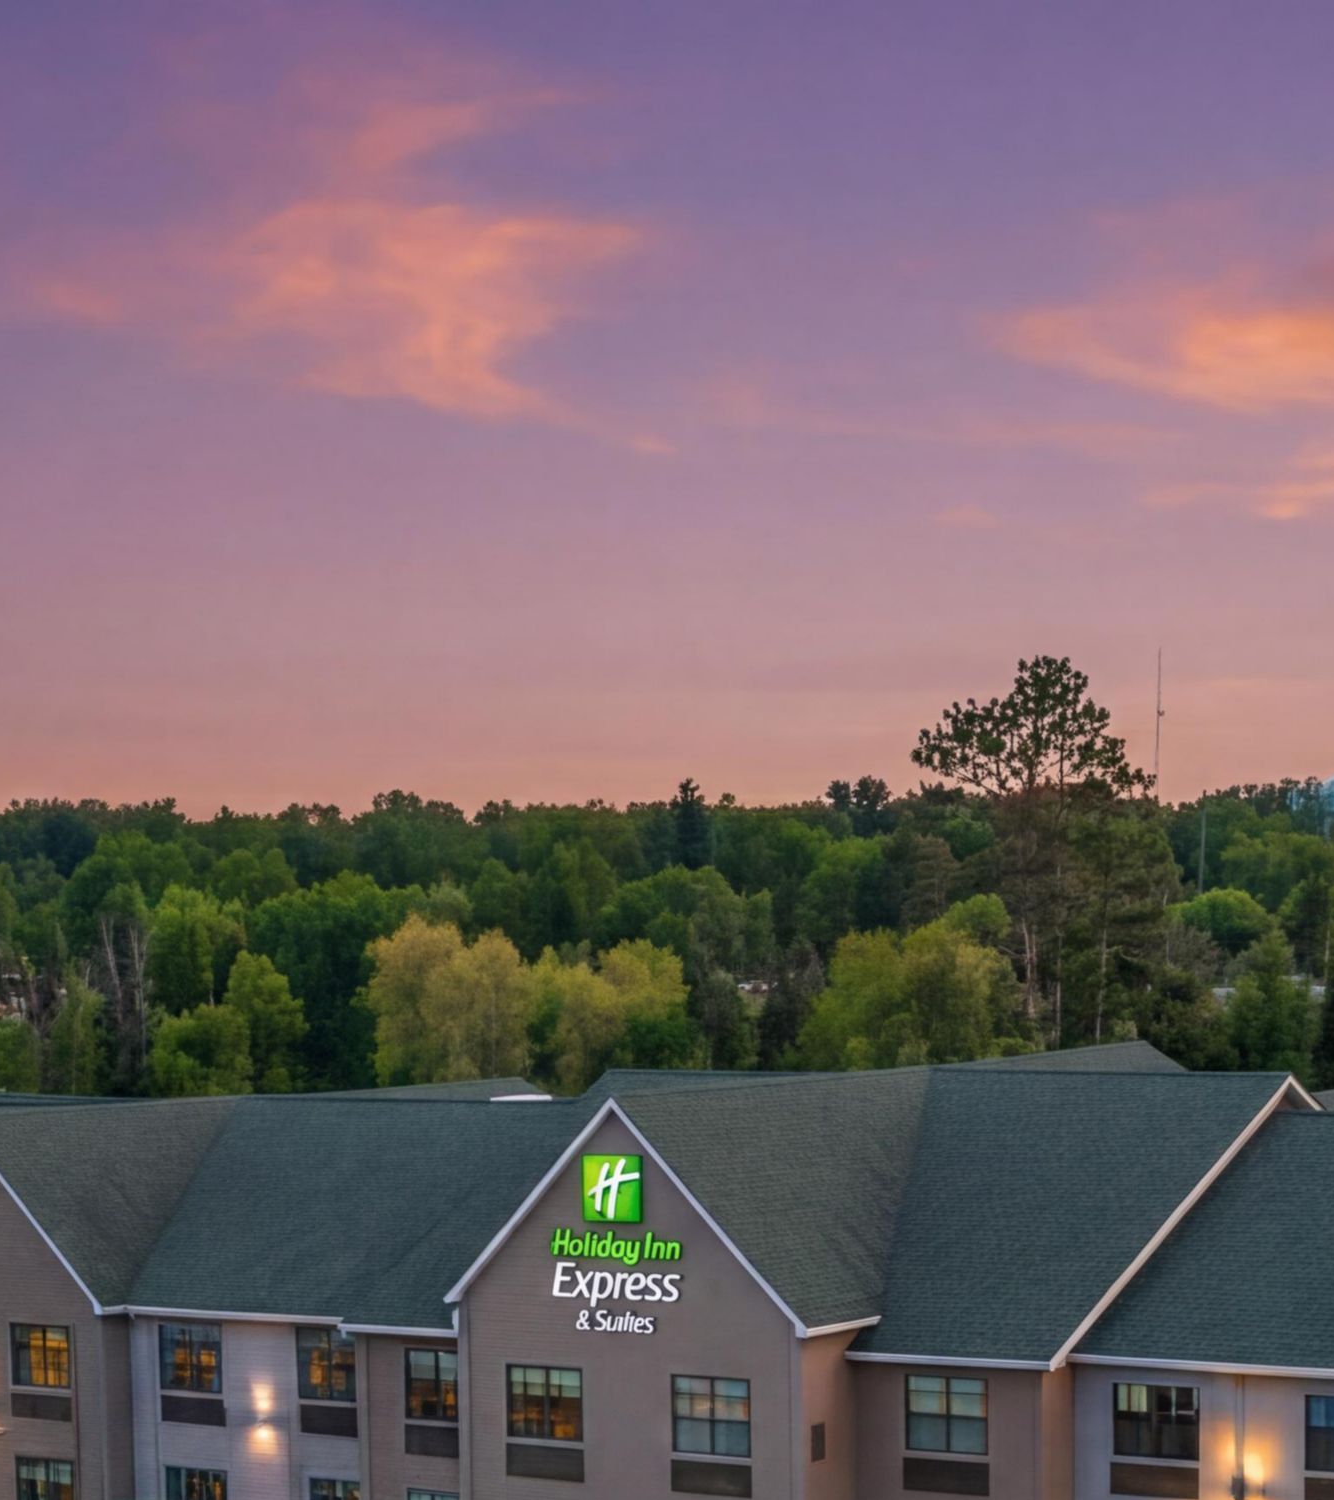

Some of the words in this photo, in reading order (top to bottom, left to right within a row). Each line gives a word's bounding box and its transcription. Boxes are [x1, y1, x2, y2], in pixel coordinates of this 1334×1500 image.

[551, 1228, 640, 1265] Holiday
[644, 1232, 681, 1260] Inn
[552, 1261, 681, 1308] Express
[575, 1309, 590, 1331] &
